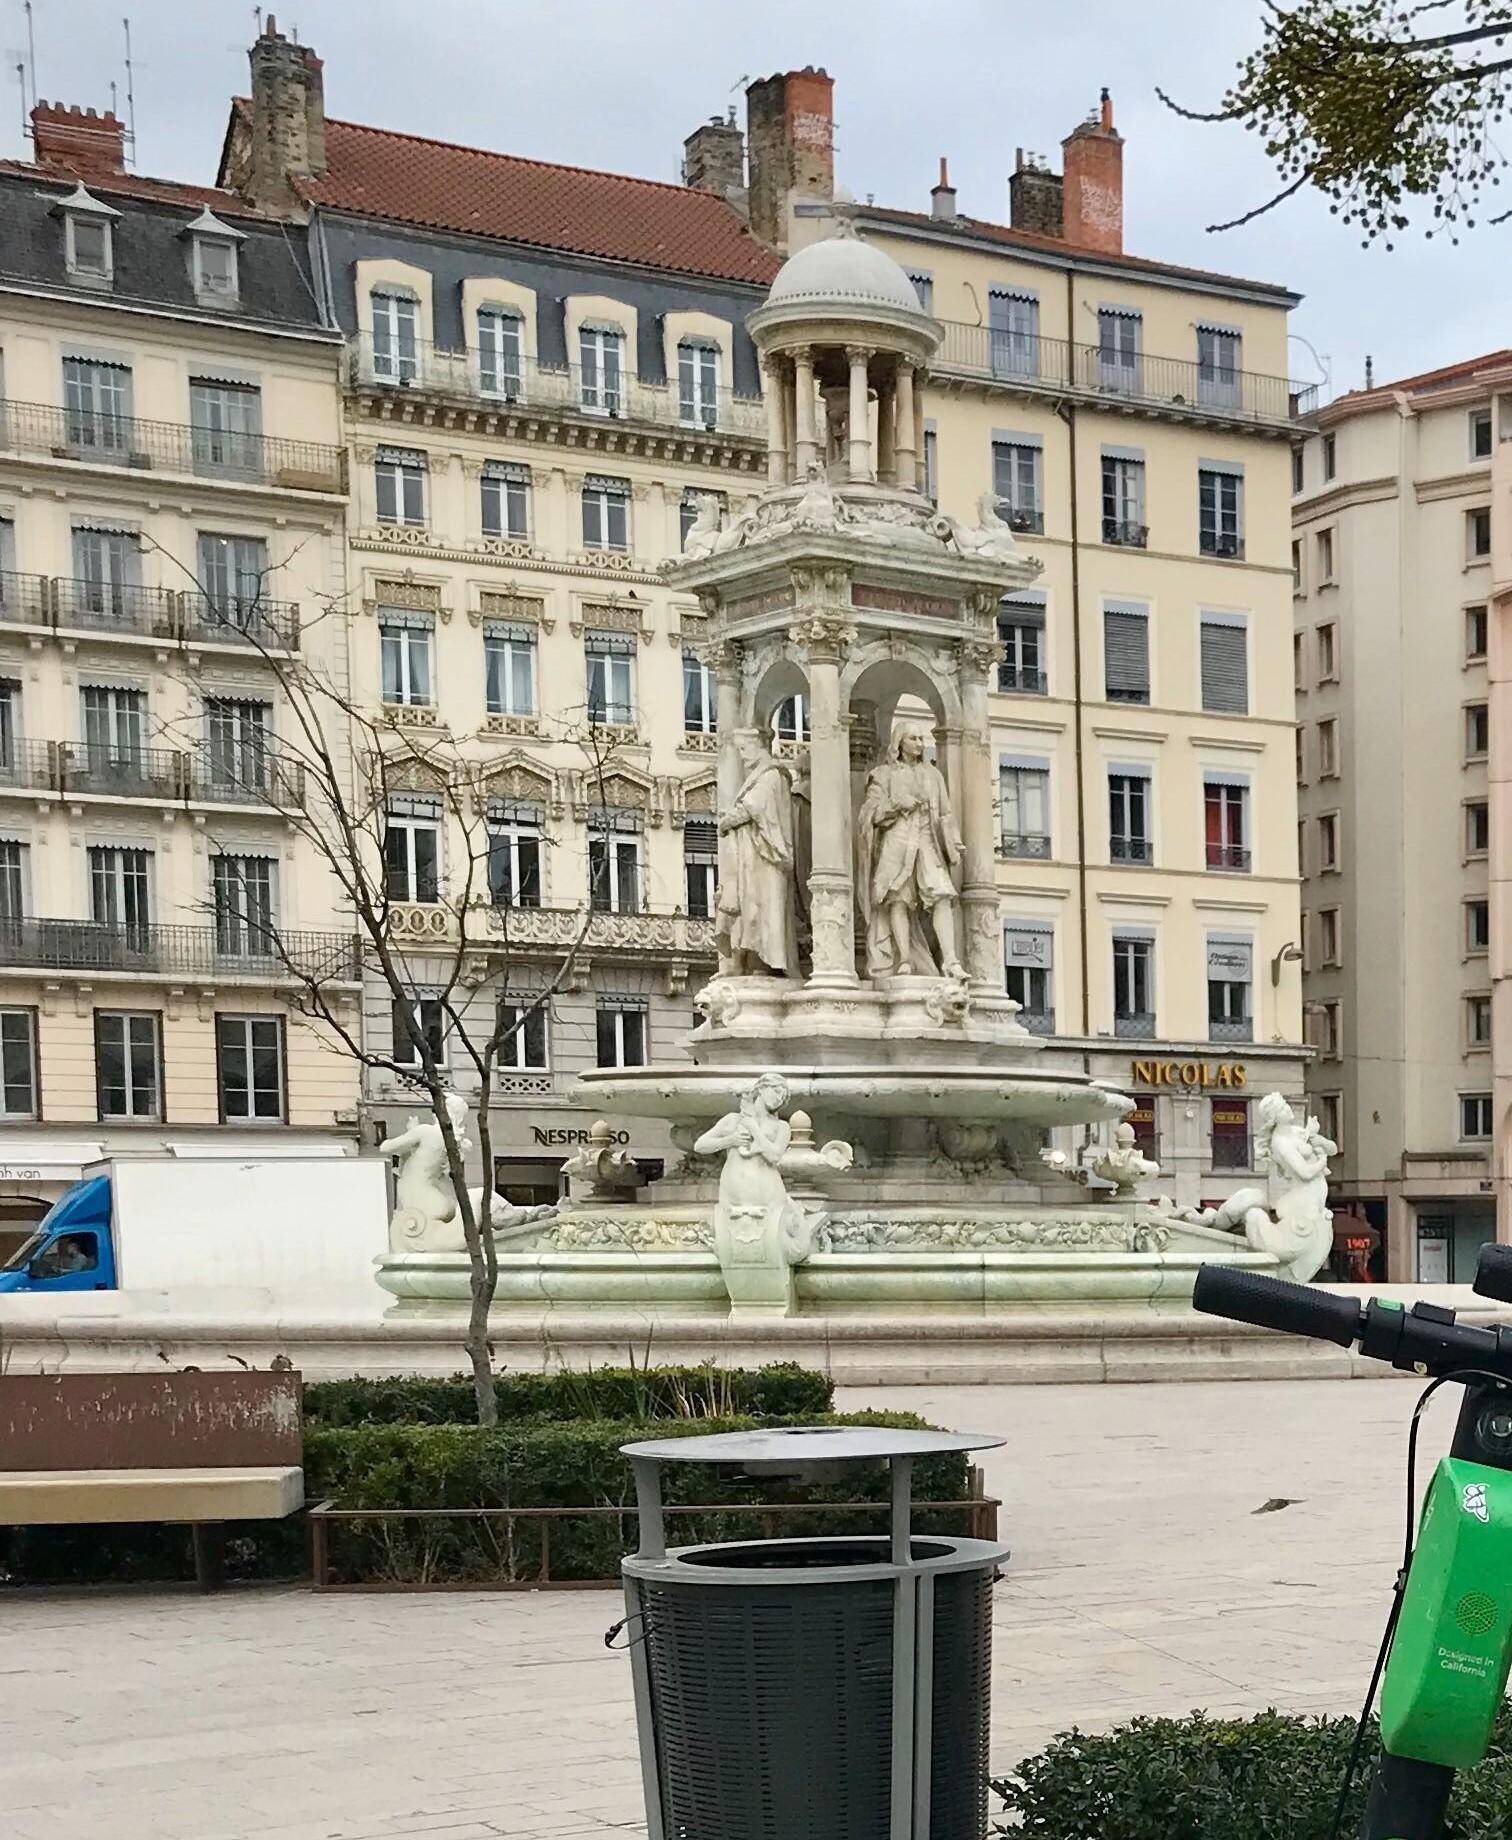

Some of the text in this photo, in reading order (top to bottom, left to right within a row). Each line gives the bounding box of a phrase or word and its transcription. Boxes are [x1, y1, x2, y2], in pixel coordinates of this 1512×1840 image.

[1132, 1061, 1249, 1088] NICOLAS
[529, 1126, 630, 1146] NESPRSO
[17, 1170, 41, 1179] van
[1438, 1647, 1483, 1665] Designed
[1440, 1659, 1486, 1678] California
